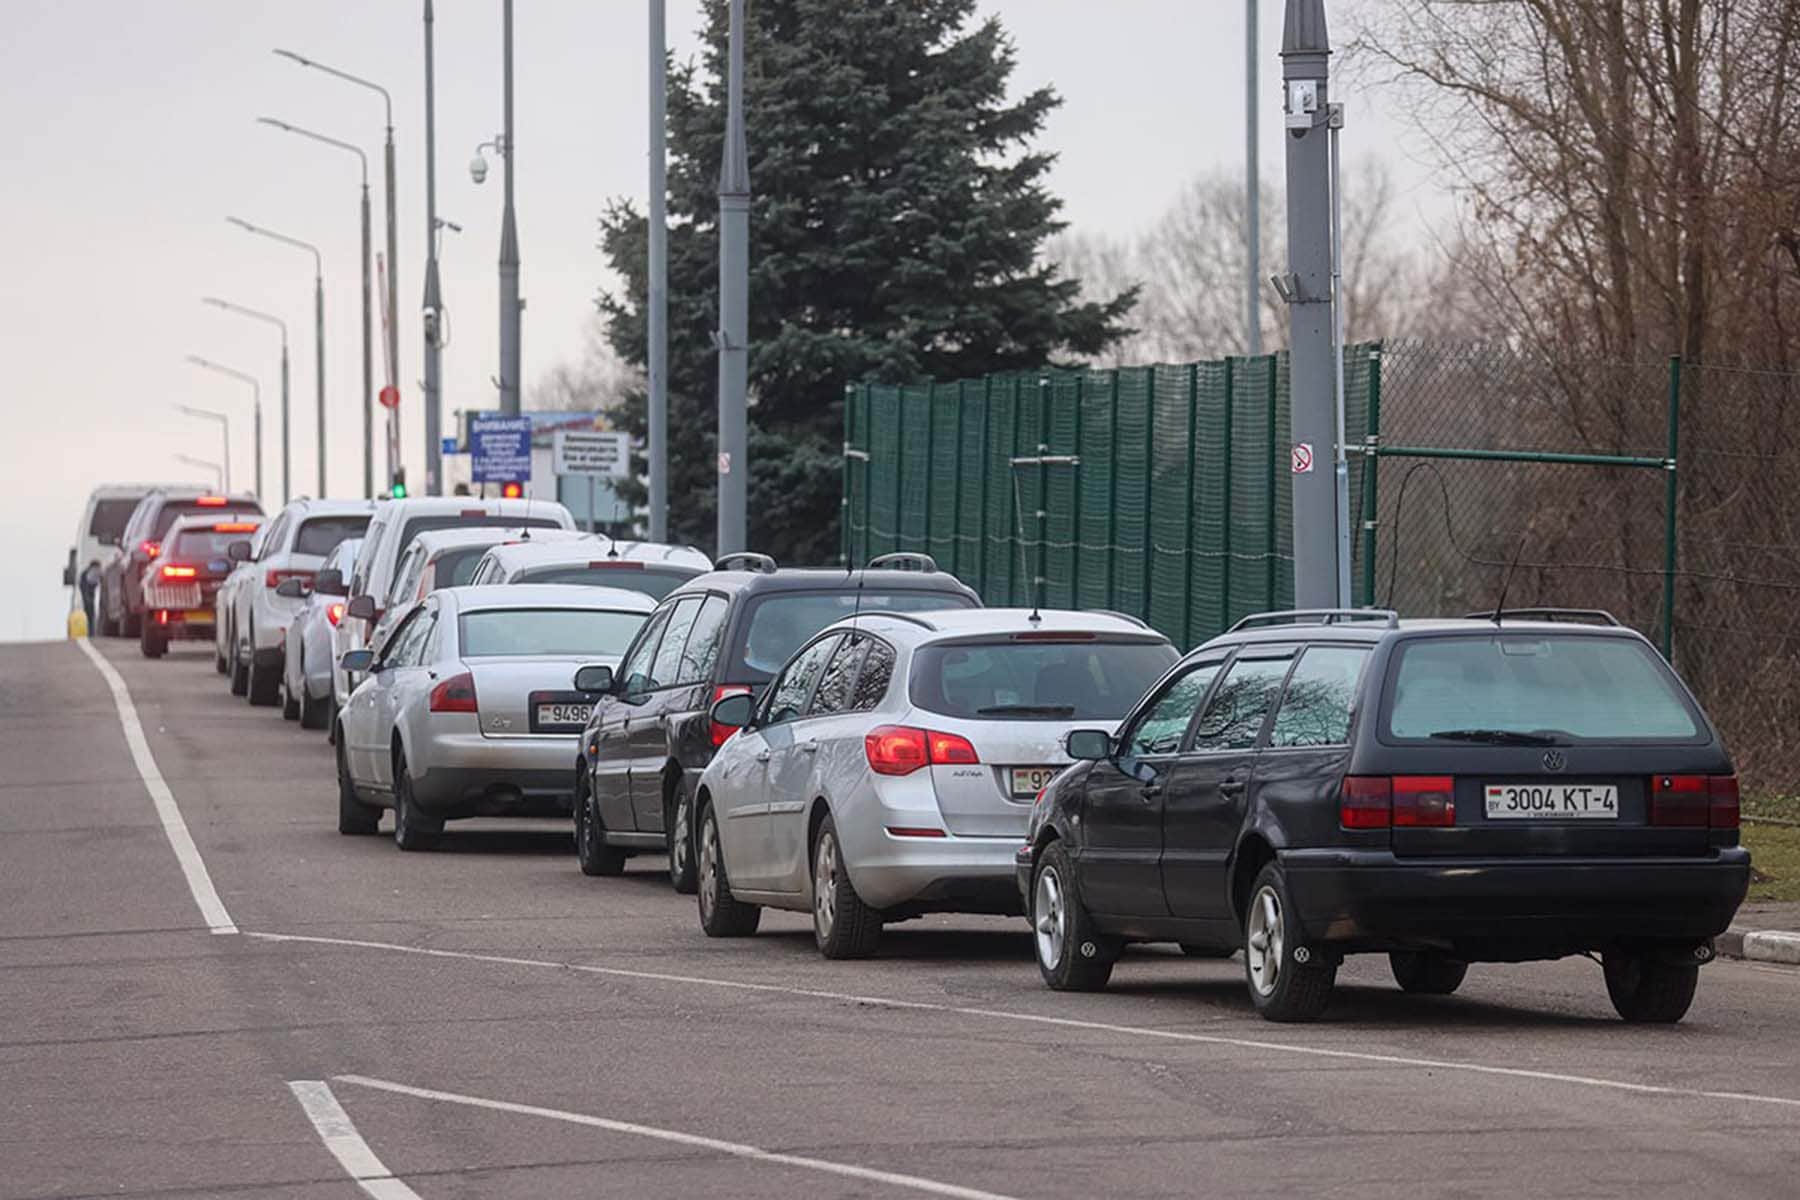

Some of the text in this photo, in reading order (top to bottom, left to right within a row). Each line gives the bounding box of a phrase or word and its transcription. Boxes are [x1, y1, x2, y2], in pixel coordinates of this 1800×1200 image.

[553, 706, 590, 721] 9496
[1506, 788, 1615, 811] 3004 KT-4
